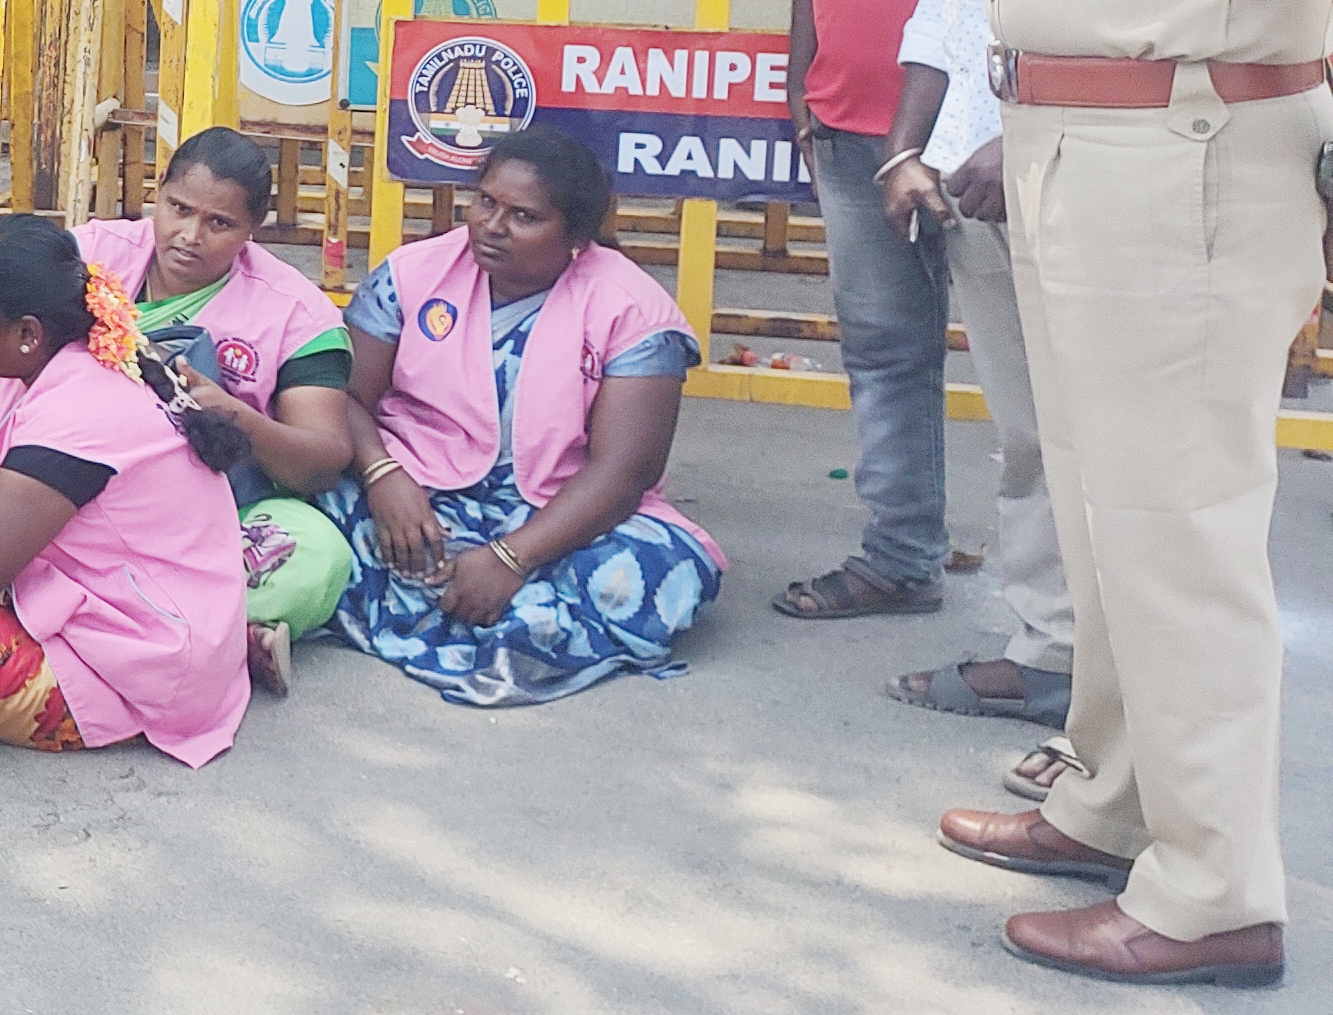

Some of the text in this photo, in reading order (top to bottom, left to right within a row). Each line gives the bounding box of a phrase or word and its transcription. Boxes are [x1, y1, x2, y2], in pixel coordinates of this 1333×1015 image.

[415, 43, 529, 99] TAMILNADU POLICE
[561, 44, 790, 103] RANIPE
